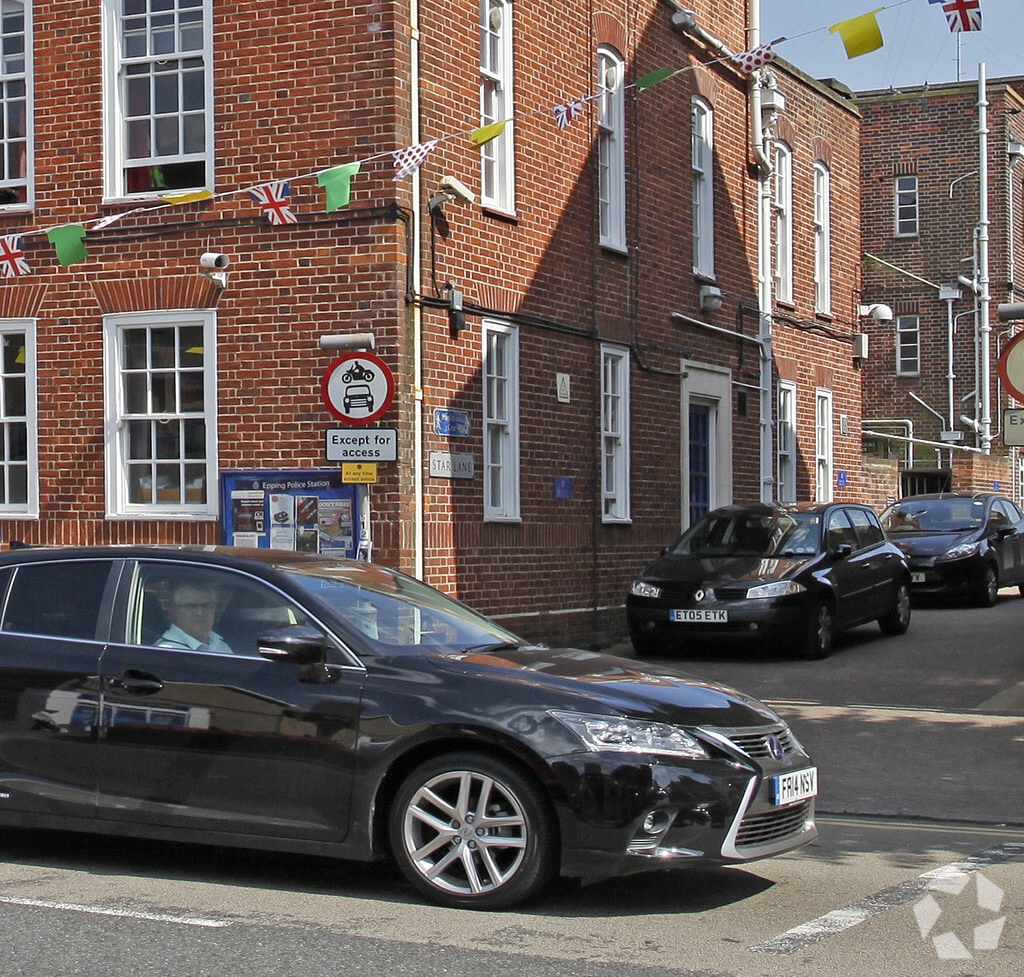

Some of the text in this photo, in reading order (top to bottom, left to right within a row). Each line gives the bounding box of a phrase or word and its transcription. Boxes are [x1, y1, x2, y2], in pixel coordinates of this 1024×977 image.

[332, 435, 390, 446] Except for
[342, 449, 380, 457] access
[432, 459, 472, 473] STAR LANE
[262, 480, 330, 490] Epping Police Station
[676, 610, 725, 620] ET05 ETK
[782, 771, 814, 799] FR14 NSV
